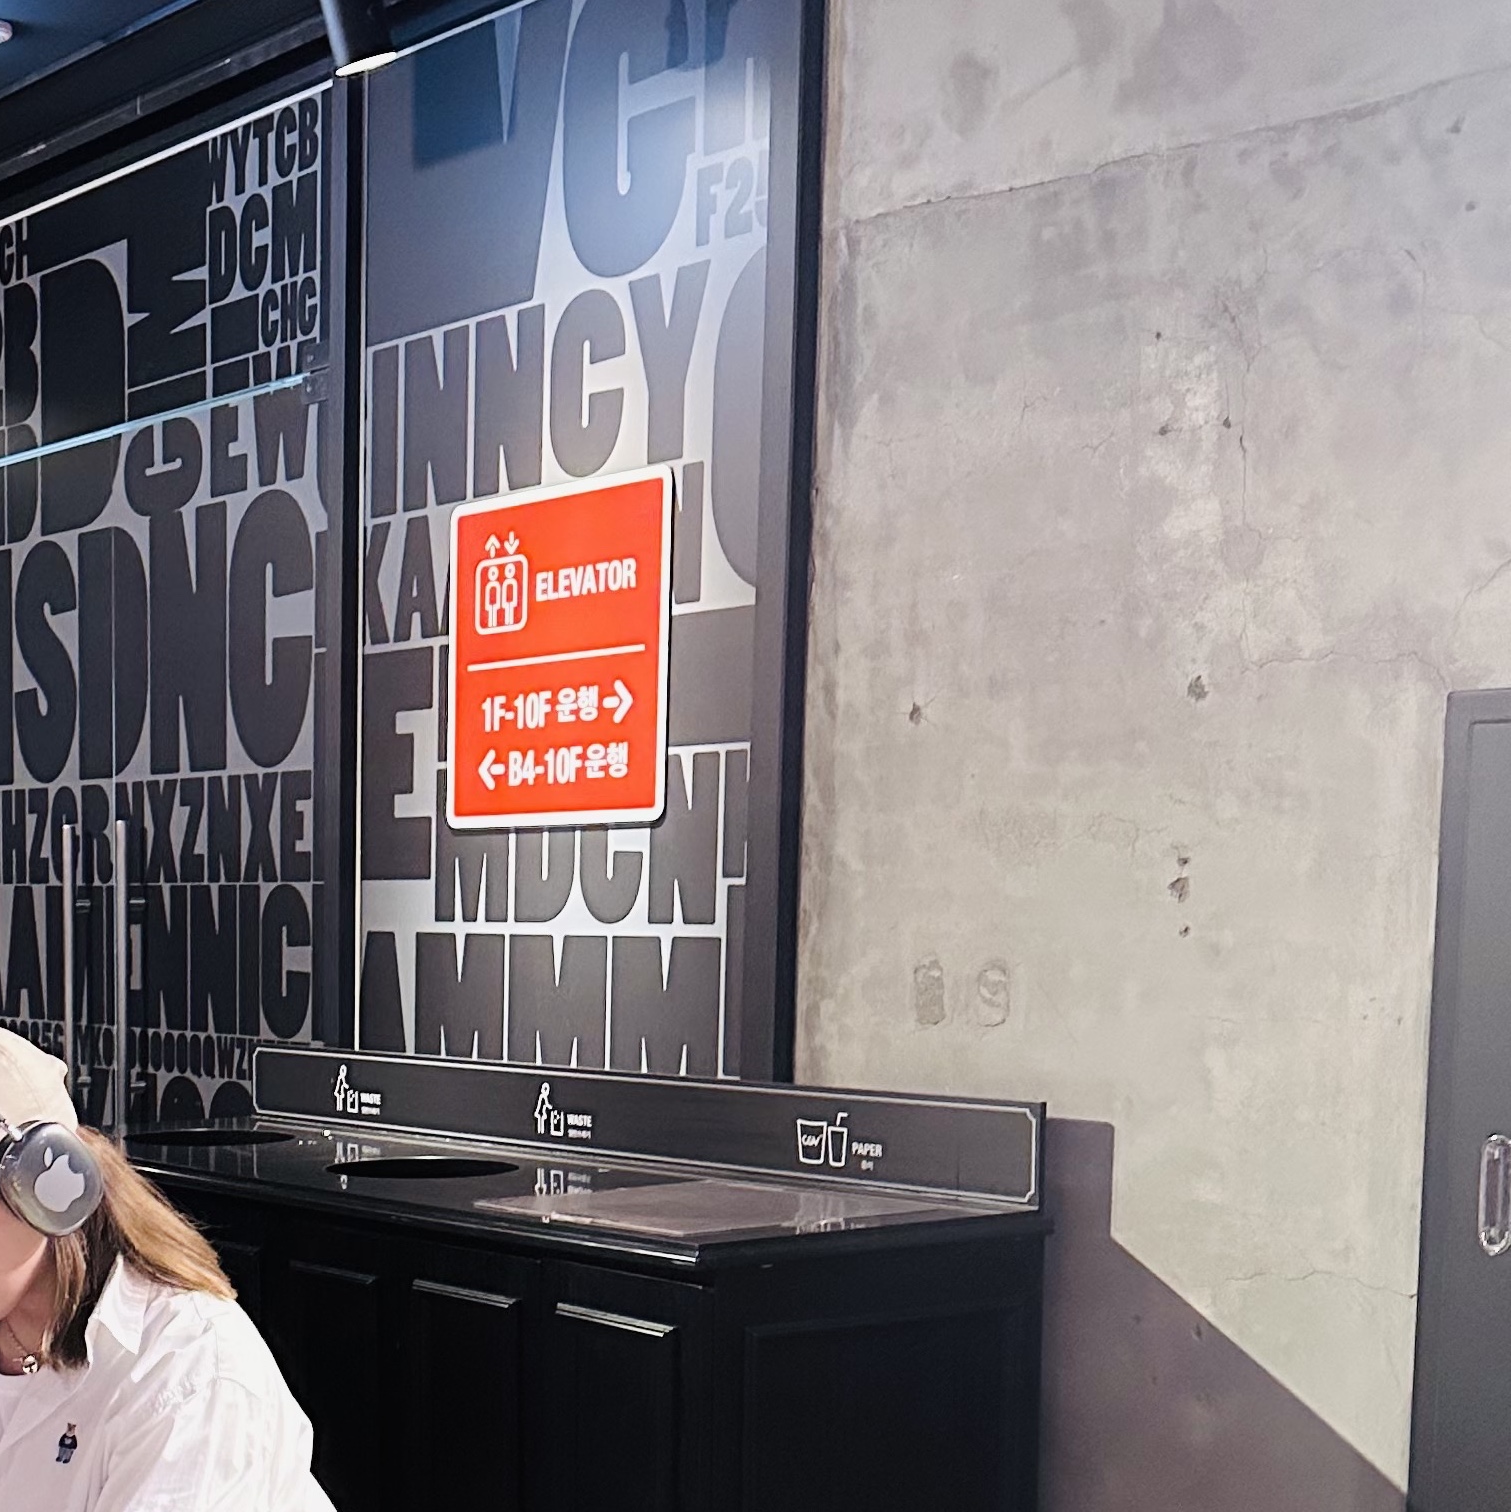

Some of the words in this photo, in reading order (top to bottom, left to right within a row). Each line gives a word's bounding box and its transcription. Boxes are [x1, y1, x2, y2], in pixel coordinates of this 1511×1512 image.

[208, 170, 318, 305] DCM
[537, 558, 636, 601] ELEVATOR
[481, 690, 552, 733] 1F-10F
[555, 684, 599, 724] 운행
[508, 746, 583, 788] B4-10F
[585, 741, 629, 779] 운행
[566, 1113, 592, 1128] WASTE
[851, 1141, 883, 1158] PAPER
